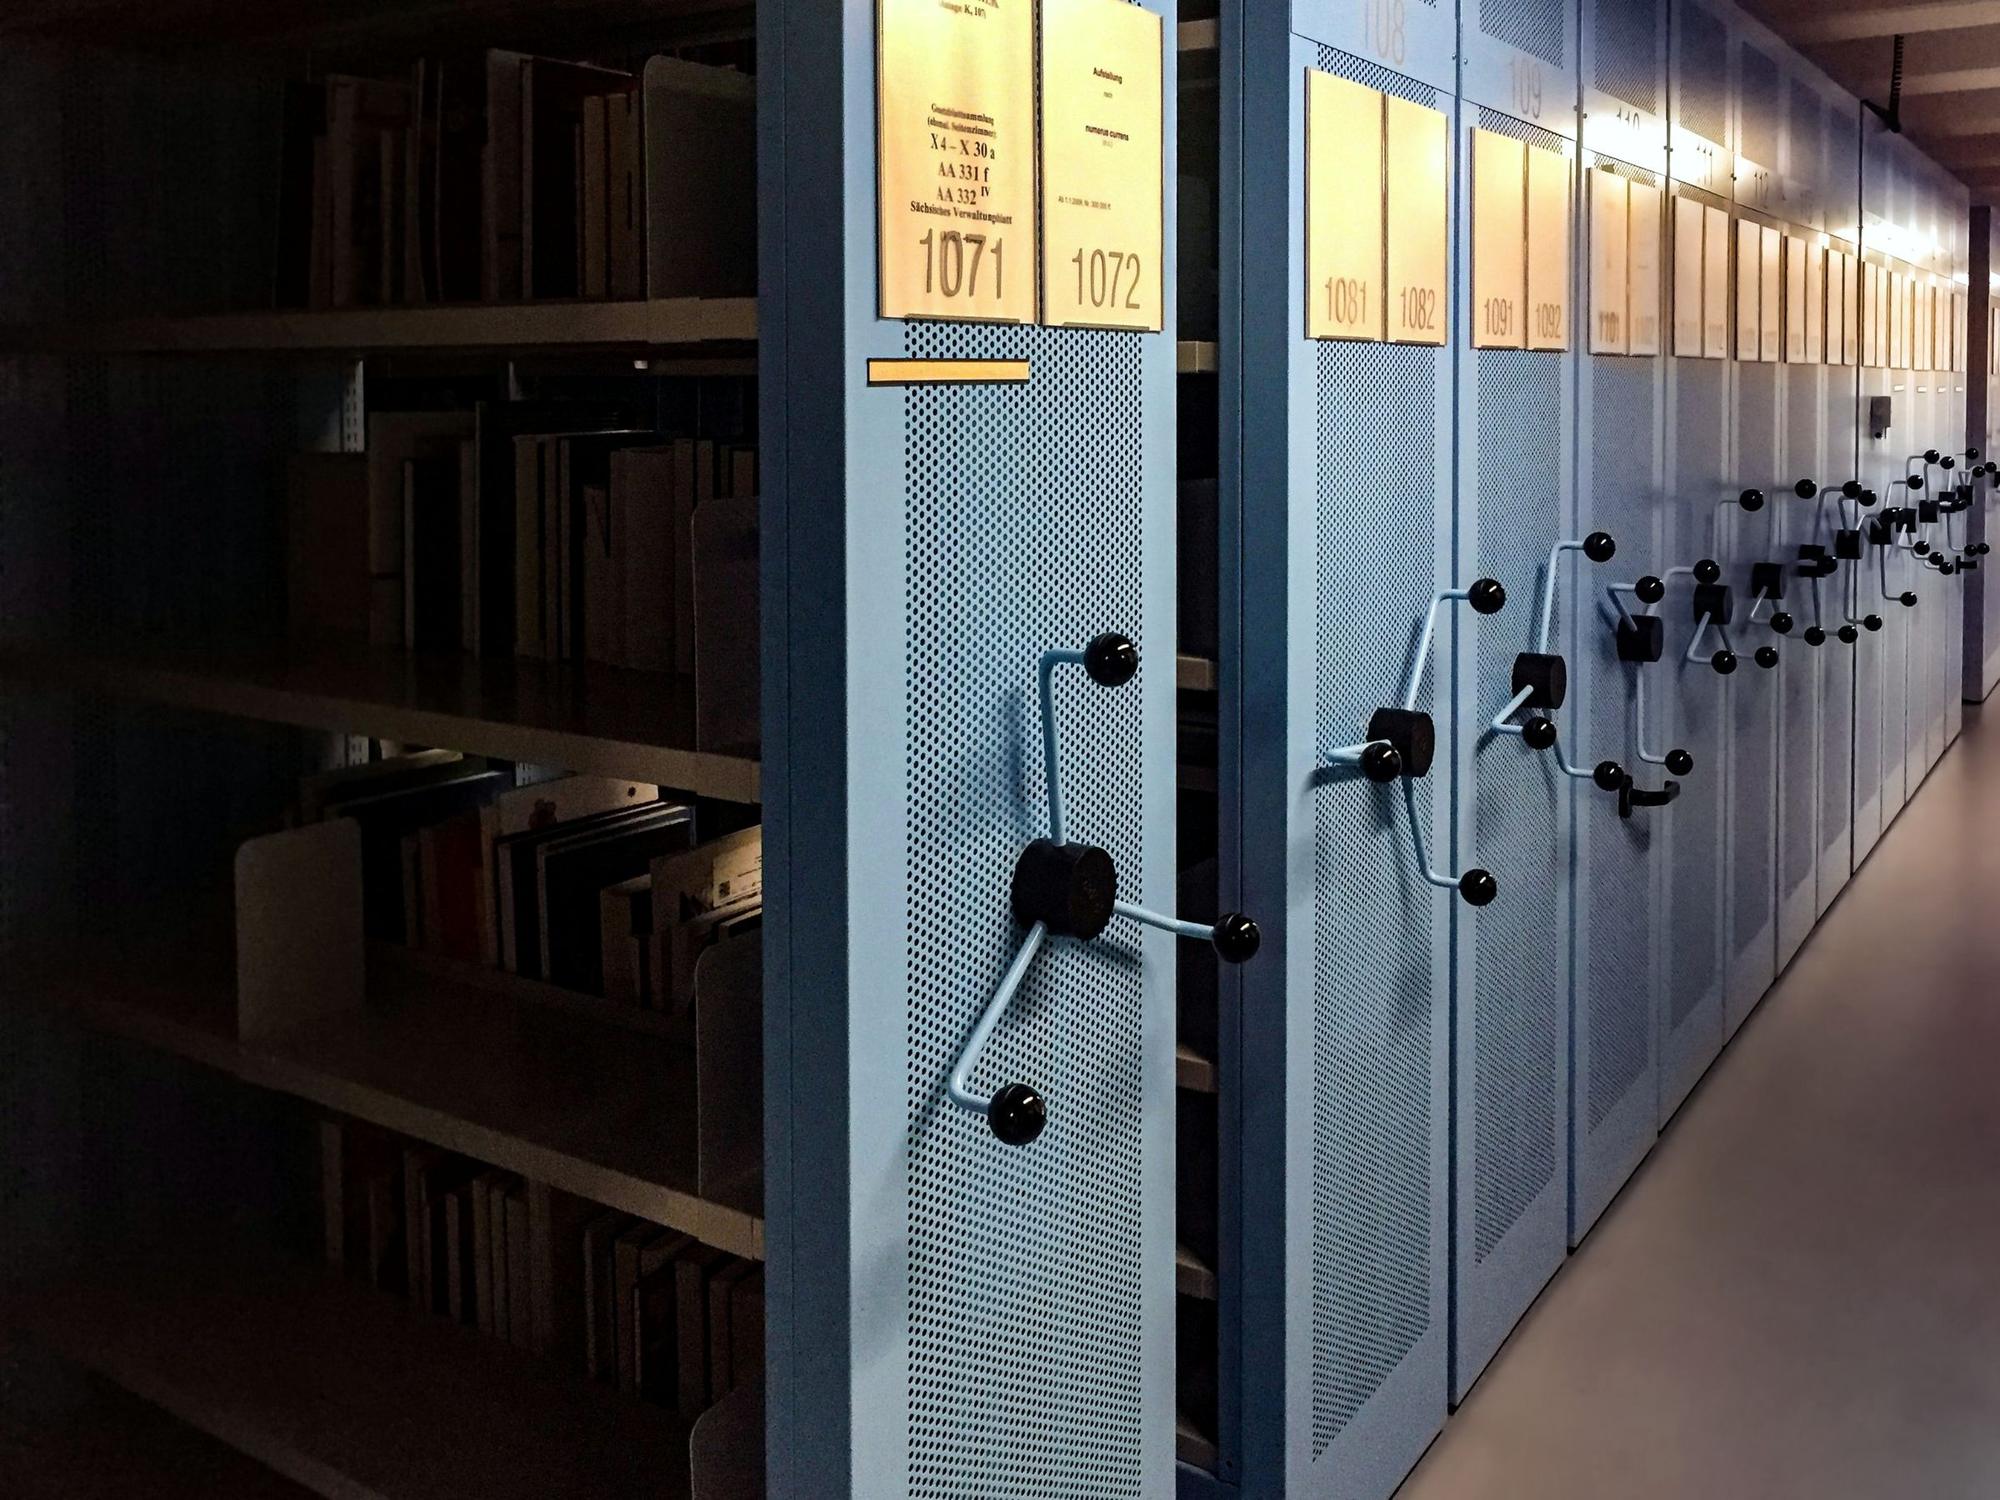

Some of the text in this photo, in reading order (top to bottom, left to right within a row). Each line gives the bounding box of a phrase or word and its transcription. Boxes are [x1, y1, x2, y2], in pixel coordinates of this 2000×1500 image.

[1511, 55, 1542, 119] 109
[960, 139, 970, 156] X
[973, 141, 988, 158] 30
[990, 148, 996, 160] a
[938, 161, 990, 182] AA 331 f
[937, 185, 954, 203] AA
[957, 187, 977, 205] 332
[919, 227, 1141, 309] 1071 1072
[1325, 277, 1436, 330] 1081 1082
[1484, 298, 1562, 339] 1091 1092
